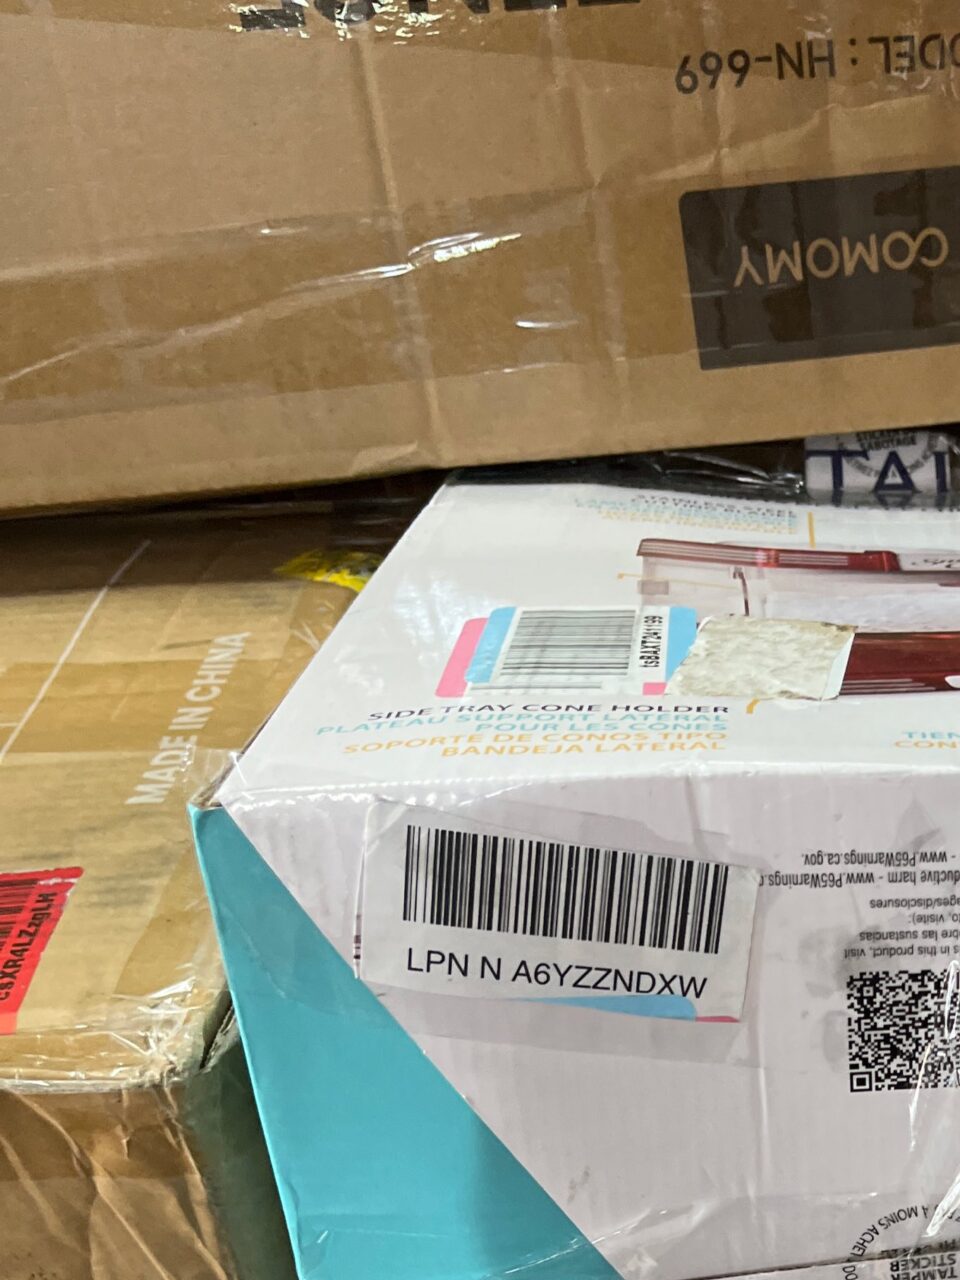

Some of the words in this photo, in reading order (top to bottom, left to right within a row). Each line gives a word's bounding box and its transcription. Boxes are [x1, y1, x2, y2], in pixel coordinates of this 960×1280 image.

[674, 39, 836, 95] HN-669
[734, 226, 949, 287] COMOMY
[186, 631, 251, 701] CHINA
[172, 698, 214, 738] IN
[368, 707, 433, 721] SIDE
[441, 704, 514, 713] TRAY
[521, 703, 602, 712] CONE
[611, 704, 729, 714] HOLDER
[316, 716, 447, 736] PLATEAU
[456, 713, 595, 722] SUPPORT
[475, 722, 559, 732] POUR
[569, 722, 620, 731] LES
[343, 734, 484, 754] SOPORTE
[493, 733, 532, 743] DE
[542, 732, 648, 742] CONOS
[656, 731, 727, 741] TIPO
[442, 743, 584, 757] BANDEJA
[594, 741, 726, 753] LATERAL
[126, 735, 198, 806] MADE
[801, 850, 948, 867] www.P65Warnings.ca.gov.
[887, 870, 917, 886] harm
[859, 930, 919, 942] sustancias
[921, 930, 938, 942] las
[842, 948, 866, 960] visit
[917, 945, 937, 957] this
[940, 946, 950, 956] in
[406, 947, 470, 978] LPN
[479, 955, 502, 981] N
[511, 959, 708, 999] A6YZZNDXW
[878, 1205, 919, 1230] MOINS
[889, 1252, 957, 1273] STICKER
